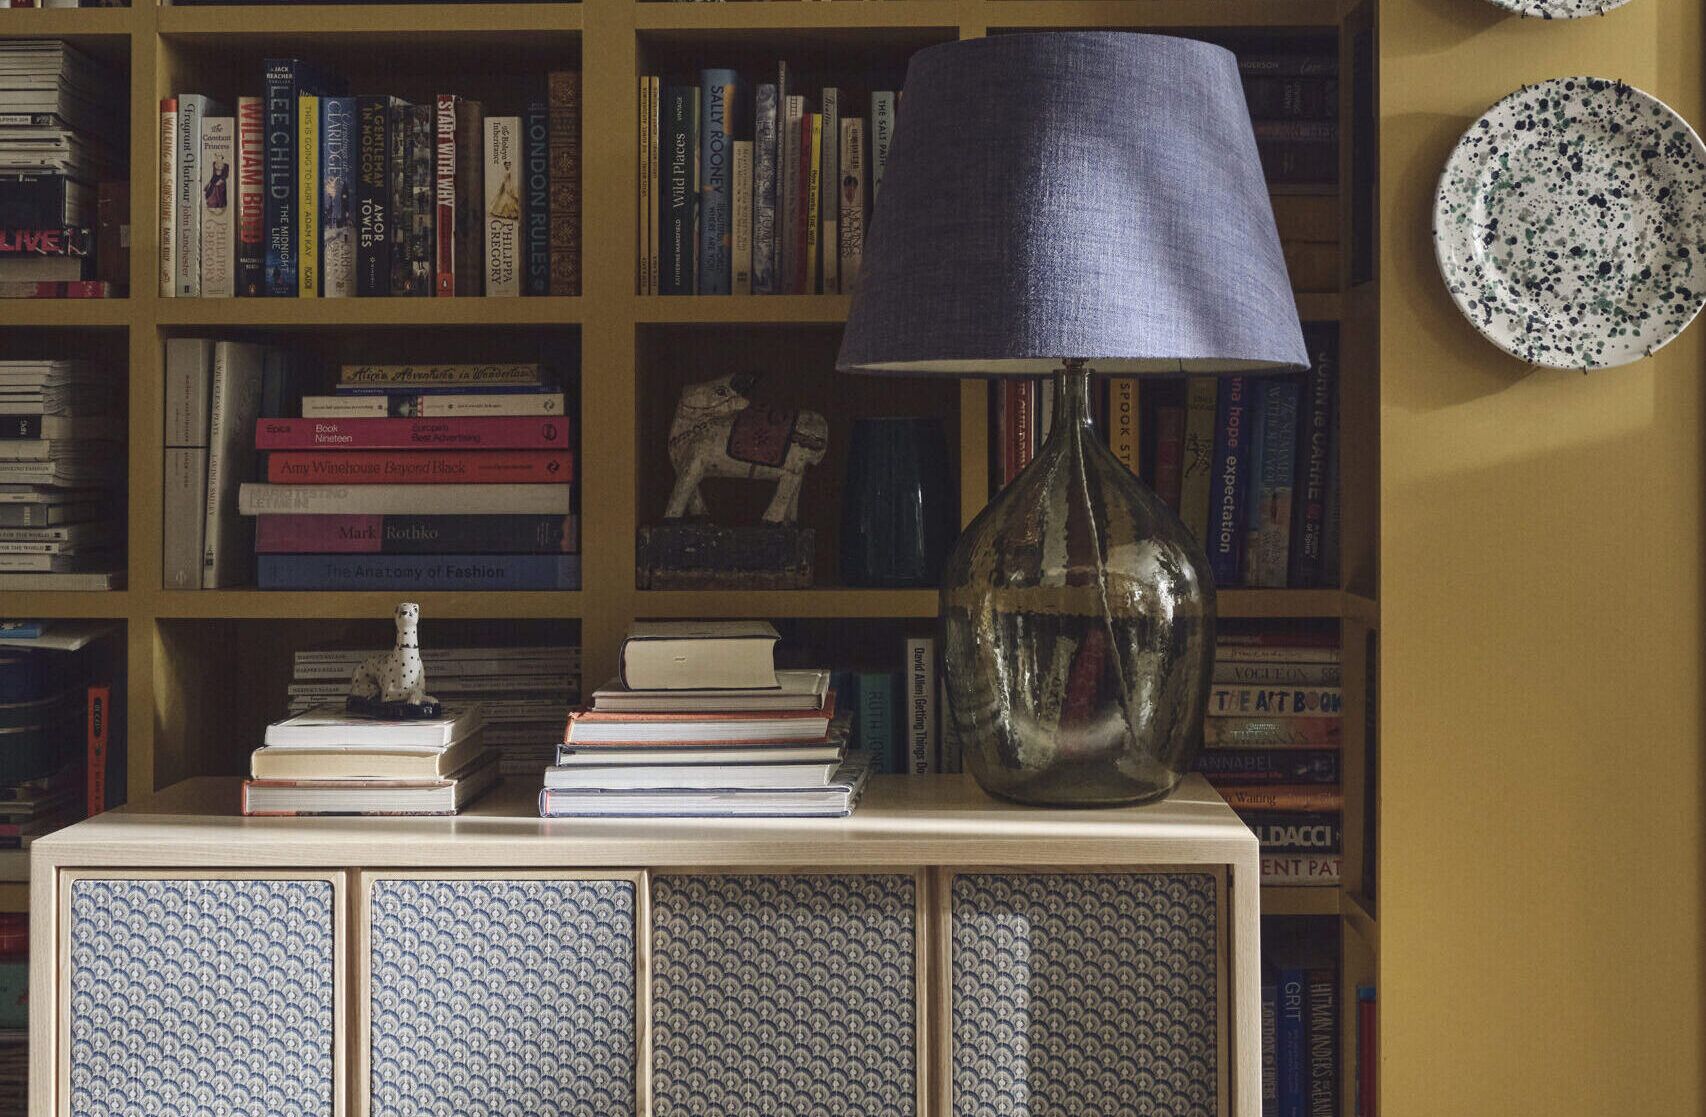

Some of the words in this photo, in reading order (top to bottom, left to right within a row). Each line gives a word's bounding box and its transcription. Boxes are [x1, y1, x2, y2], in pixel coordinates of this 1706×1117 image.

[270, 86, 289, 126] LEE
[304, 105, 312, 125] THIS
[362, 107, 372, 118] IN
[438, 101, 454, 140] START
[710, 85, 723, 125] SALLY
[878, 100, 886, 117] THE
[163, 117, 174, 158] WALKING
[181, 103, 195, 152] Fragrant
[493, 122, 501, 165] Inheritance
[878, 119, 886, 141] SALT
[241, 103, 263, 186] WILLIAM
[304, 138, 312, 165] GOING
[362, 123, 372, 185] MOSCOW
[375, 115, 384, 188] GENTLEMAN
[438, 142, 454, 175] WITH
[530, 114, 546, 207] LONDON
[672, 132, 685, 175] Places
[878, 144, 887, 167] PATH
[183, 153, 195, 203] Harbour
[270, 132, 289, 200] CHILD
[710, 131, 724, 194] ROONEY
[163, 178, 174, 223] SUNSHINE
[304, 183, 312, 205] HURT
[438, 177, 454, 208] WHY
[672, 177, 685, 209] Wild
[182, 205, 194, 226] John
[241, 192, 263, 245] BOYD
[280, 204, 289, 224] THE
[304, 212, 312, 237] ADAM
[361, 199, 372, 248] TOWLES
[374, 204, 384, 241] AMOR
[707, 207, 715, 232] WHERE
[183, 228, 194, 278] Lanchester
[205, 219, 217, 284] GREGORY
[272, 227, 281, 250] LINE
[280, 226, 289, 272] MIDNIGHT
[304, 239, 312, 257] KAY
[491, 219, 502, 284] GREGORY
[502, 222, 513, 283] PHILIPPA
[530, 213, 546, 276] RULES
[707, 237, 715, 252] ARE
[1316, 353, 1334, 406] JOHN
[1120, 383, 1130, 436] SPOOK
[266, 424, 292, 436] Epica
[315, 424, 338, 433] Book
[315, 433, 352, 443] Nineteen
[411, 433, 430, 443] Best
[431, 433, 481, 445] Advertising
[1226, 407, 1243, 448] hope
[280, 461, 311, 476] Amy
[312, 460, 381, 473] Winehouse
[383, 460, 432, 475] Beyond
[432, 460, 465, 473] Black
[1219, 455, 1238, 553] expectation
[339, 525, 377, 539] Mark
[385, 525, 440, 539] Rothko
[326, 565, 351, 578] The
[354, 565, 422, 581] Anatomy
[427, 565, 442, 578] of
[446, 565, 505, 578] Fashion
[914, 647, 925, 671] David
[1234, 667, 1285, 680] VOGUE
[914, 674, 925, 695] Allen
[1215, 690, 1250, 712] THE
[1255, 690, 1290, 712] ART
[868, 690, 883, 729] RUTH
[913, 698, 927, 730] Getting
[867, 735, 884, 774] JONE
[913, 731, 928, 759] Things
[917, 761, 928, 774] Do
[1236, 791, 1276, 807] Waiting
[1257, 825, 1331, 846] LDACCI
[1261, 859, 1302, 876] ENT
[1309, 859, 1344, 876] PAT
[1284, 981, 1301, 1023] GRIT
[1311, 983, 1333, 1031] HITMAN
[1311, 1034, 1334, 1077] ANDERS
